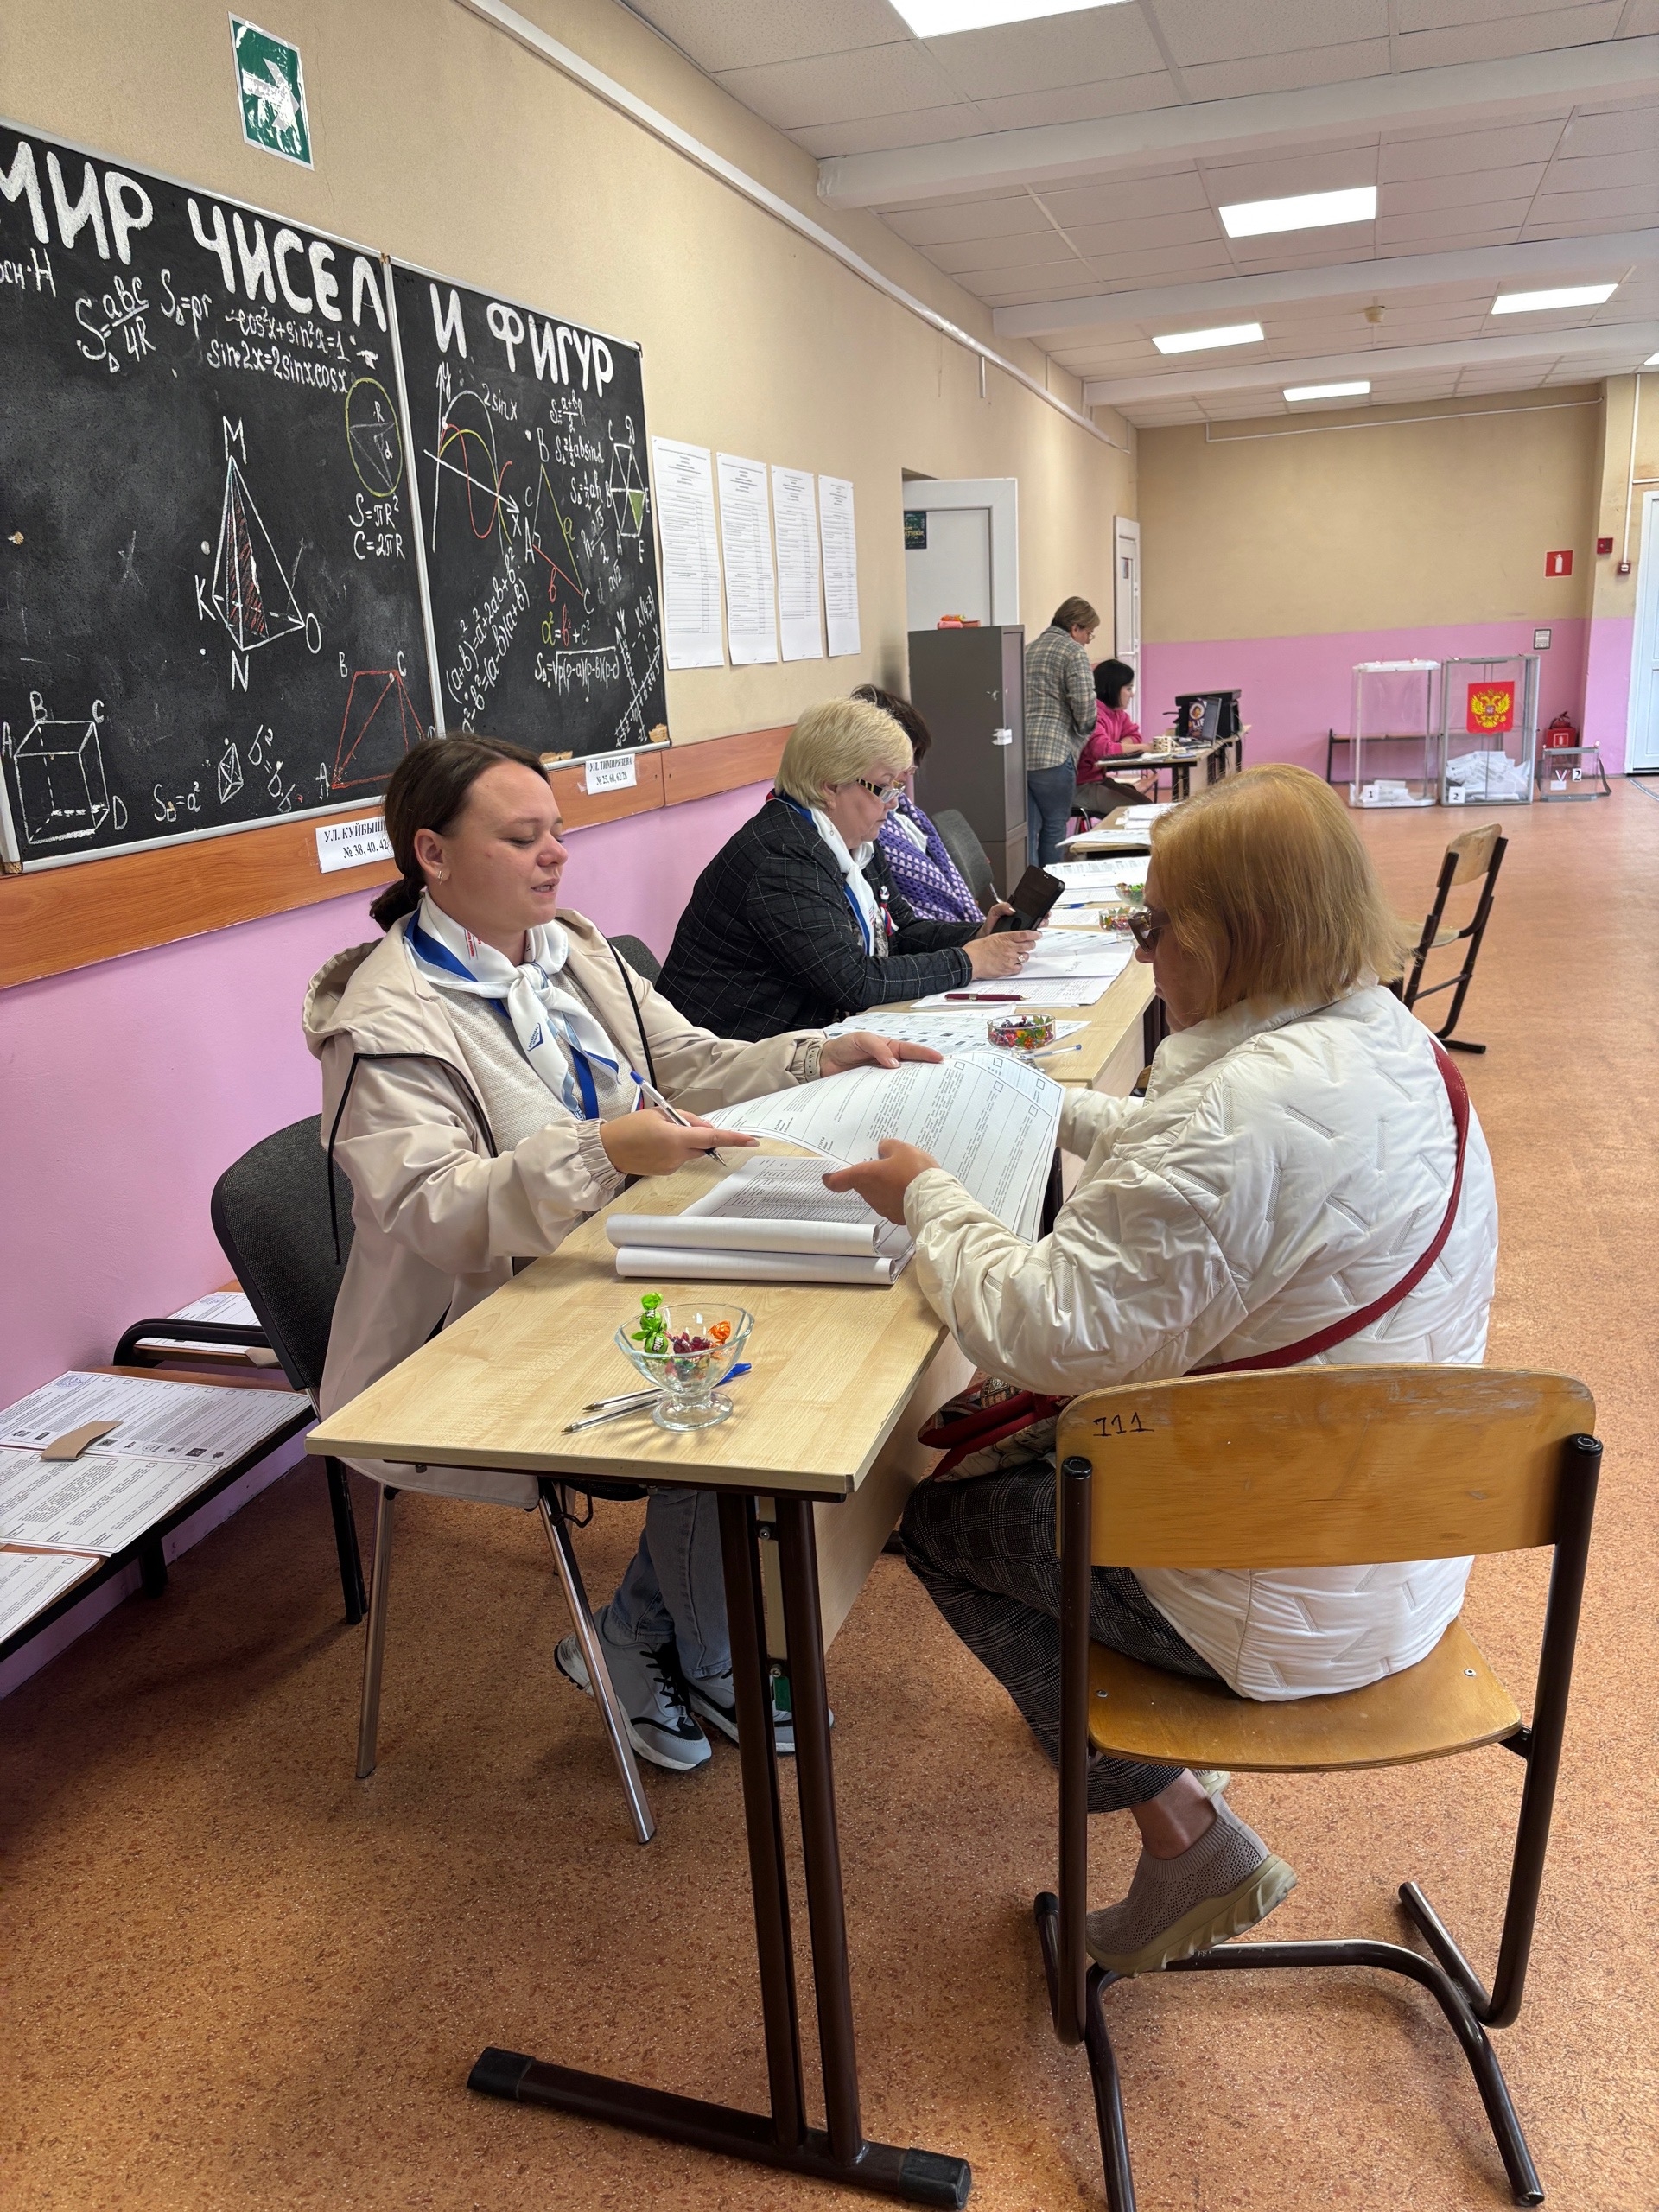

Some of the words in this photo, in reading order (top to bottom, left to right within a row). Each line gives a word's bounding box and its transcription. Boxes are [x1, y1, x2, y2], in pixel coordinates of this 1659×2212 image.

[0, 141, 154, 265] МИР
[188, 198, 387, 333] ЧИСЕЛ
[429, 283, 467, 359] И
[486, 302, 614, 398] ФИГУР
[324, 830, 340, 843] УЛ.
[342, 847, 353, 858] №
[353, 843, 366, 856] 38,
[367, 841, 378, 854] 40,
